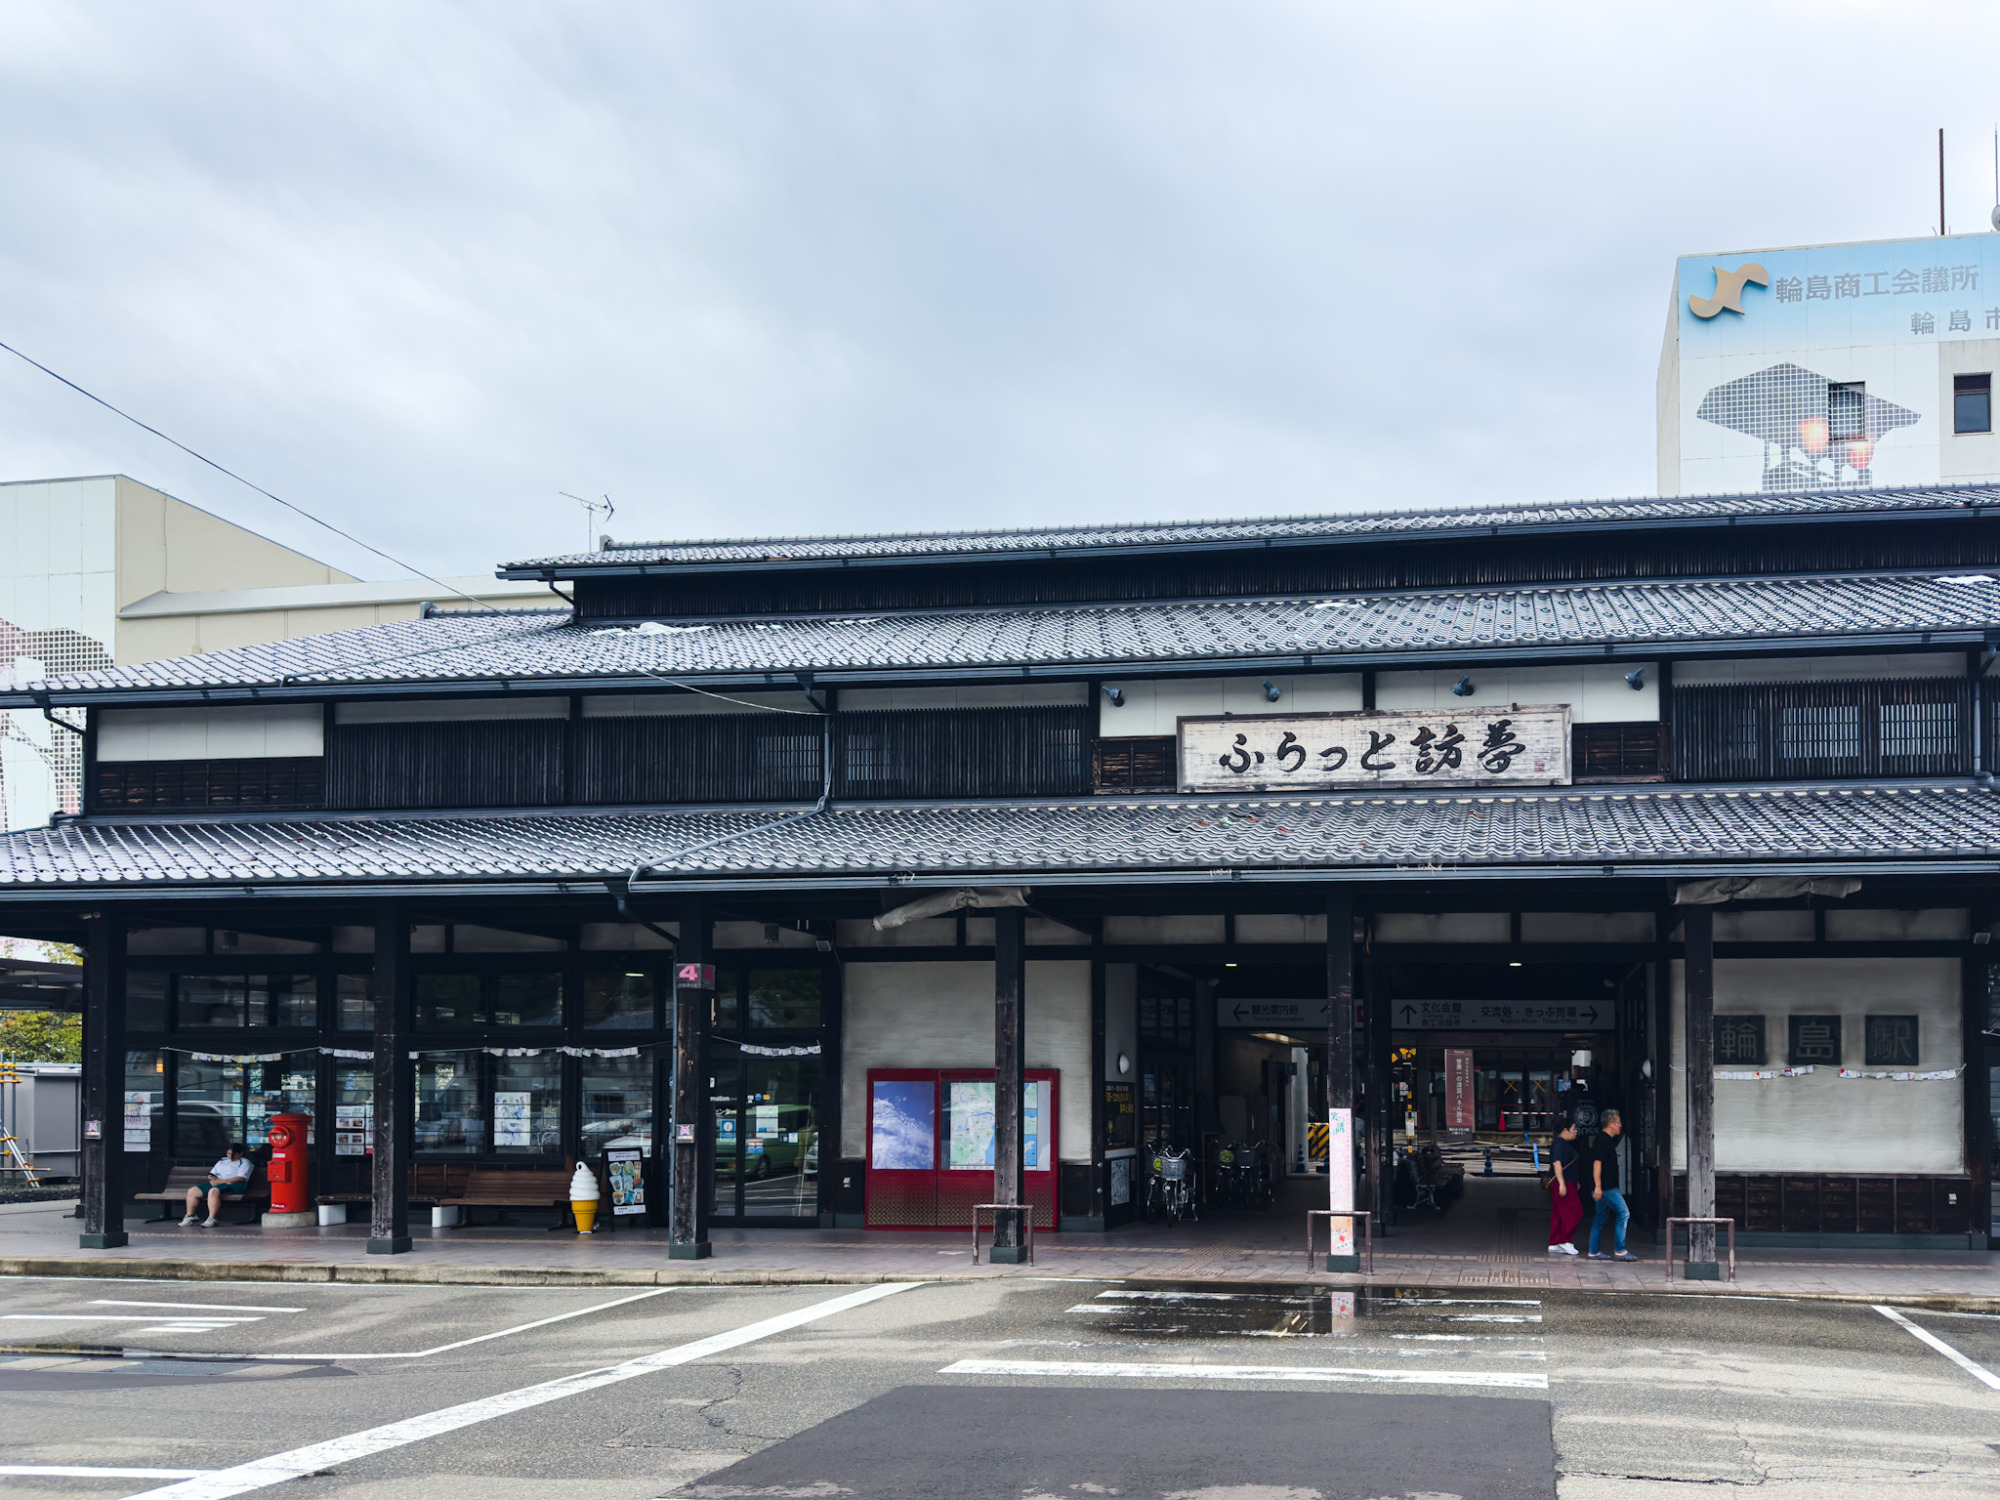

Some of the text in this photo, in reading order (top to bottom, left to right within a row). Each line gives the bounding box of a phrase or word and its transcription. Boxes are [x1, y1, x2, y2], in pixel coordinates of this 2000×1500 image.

[1775, 264, 1979, 304] 輪島商工会議所
[1218, 718, 1526, 775] ふらっと訪夢
[679, 964, 698, 981] 4
[1252, 1004, 1299, 1016] 観光案内処
[1421, 1002, 1462, 1013] 文化会館
[1719, 1020, 1913, 1061] 輪島駅
